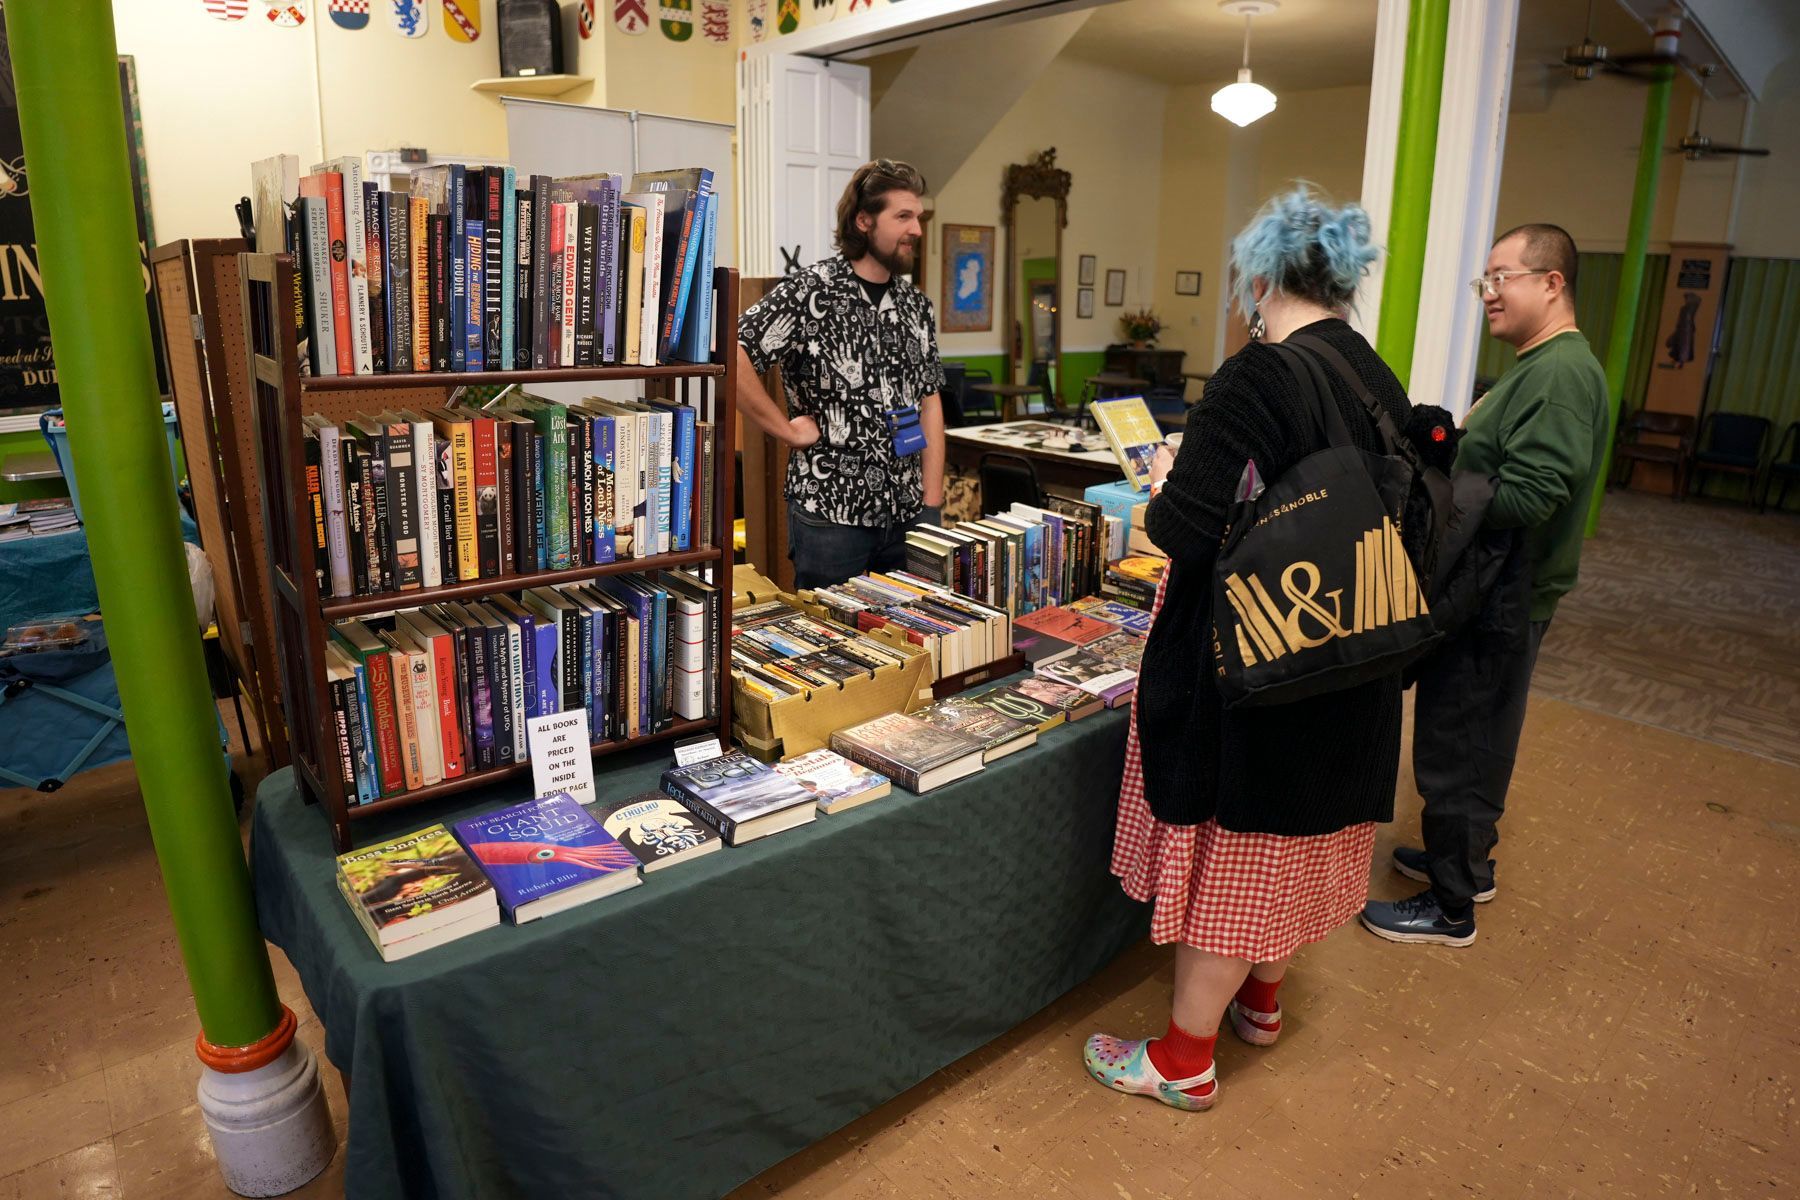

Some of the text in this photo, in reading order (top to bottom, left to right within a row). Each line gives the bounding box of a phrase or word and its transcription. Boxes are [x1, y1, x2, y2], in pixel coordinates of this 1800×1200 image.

[352, 163, 363, 254] Astonishing Animals
[389, 207, 399, 260] DAWKINS
[399, 209, 407, 258] RICHARD
[600, 205, 609, 239] Other
[689, 211, 703, 255] GOVERNMENT
[311, 208, 321, 281] SERPENT SURPRISES
[370, 189, 382, 288] THE MAGIC OF REALITY
[468, 235, 482, 270] HIDING
[599, 241, 607, 277] Worlds
[686, 256, 694, 272] FILES
[454, 258, 464, 296] HOUDINI
[487, 229, 501, 312] CONJURING
[582, 226, 592, 325] WHY THEY KILL
[293, 273, 301, 298] World
[565, 246, 575, 326] EDWARD GEIN
[294, 298, 303, 328] Wildlife
[319, 292, 329, 332] SHUKER
[357, 285, 365, 315] FLANNERY
[470, 282, 481, 326] ELEPHANT
[396, 312, 403, 326] ON
[455, 432, 465, 448] THE
[456, 452, 467, 471] LAST
[584, 450, 592, 480] SEARCH
[350, 482, 359, 503] Bear
[399, 472, 407, 507] MONSTER
[457, 476, 469, 513] UNICORN
[584, 481, 592, 491] AT
[658, 466, 671, 532] DENIALISM
[401, 510, 407, 518] OF
[421, 475, 430, 530] MONTGOMERY
[535, 489, 543, 524] WEIRD
[584, 494, 592, 514] LOCH
[597, 465, 606, 539] of Loch Ness
[353, 503, 361, 533] Attacks
[505, 523, 512, 531] OF
[584, 515, 592, 533] NESS
[445, 524, 453, 540] Bird
[474, 637, 482, 665] PHYSICS
[499, 647, 507, 664] Myth
[476, 666, 483, 674] OF
[476, 675, 484, 686] THE
[501, 680, 509, 705] Mystery
[336, 710, 347, 735] HIPPO
[504, 706, 509, 714] of
[553, 719, 578, 729] BOOKS
[340, 736, 349, 756] EATS
[548, 746, 574, 757] PRICED
[553, 735, 566, 743] ARE
[343, 757, 354, 783] DWARF
[549, 759, 576, 770] ON THE
[552, 772, 576, 783] INSIDE
[673, 765, 708, 778] STEVE
[711, 753, 747, 767] ALTEN
[543, 782, 588, 797] FRONT PAGE
[488, 808, 560, 835] GIANT
[616, 801, 659, 821] CTHULHU
[509, 813, 579, 841] SQUID
[345, 830, 443, 864] Boss Snakes
[518, 873, 578, 896] Richard Ellis
